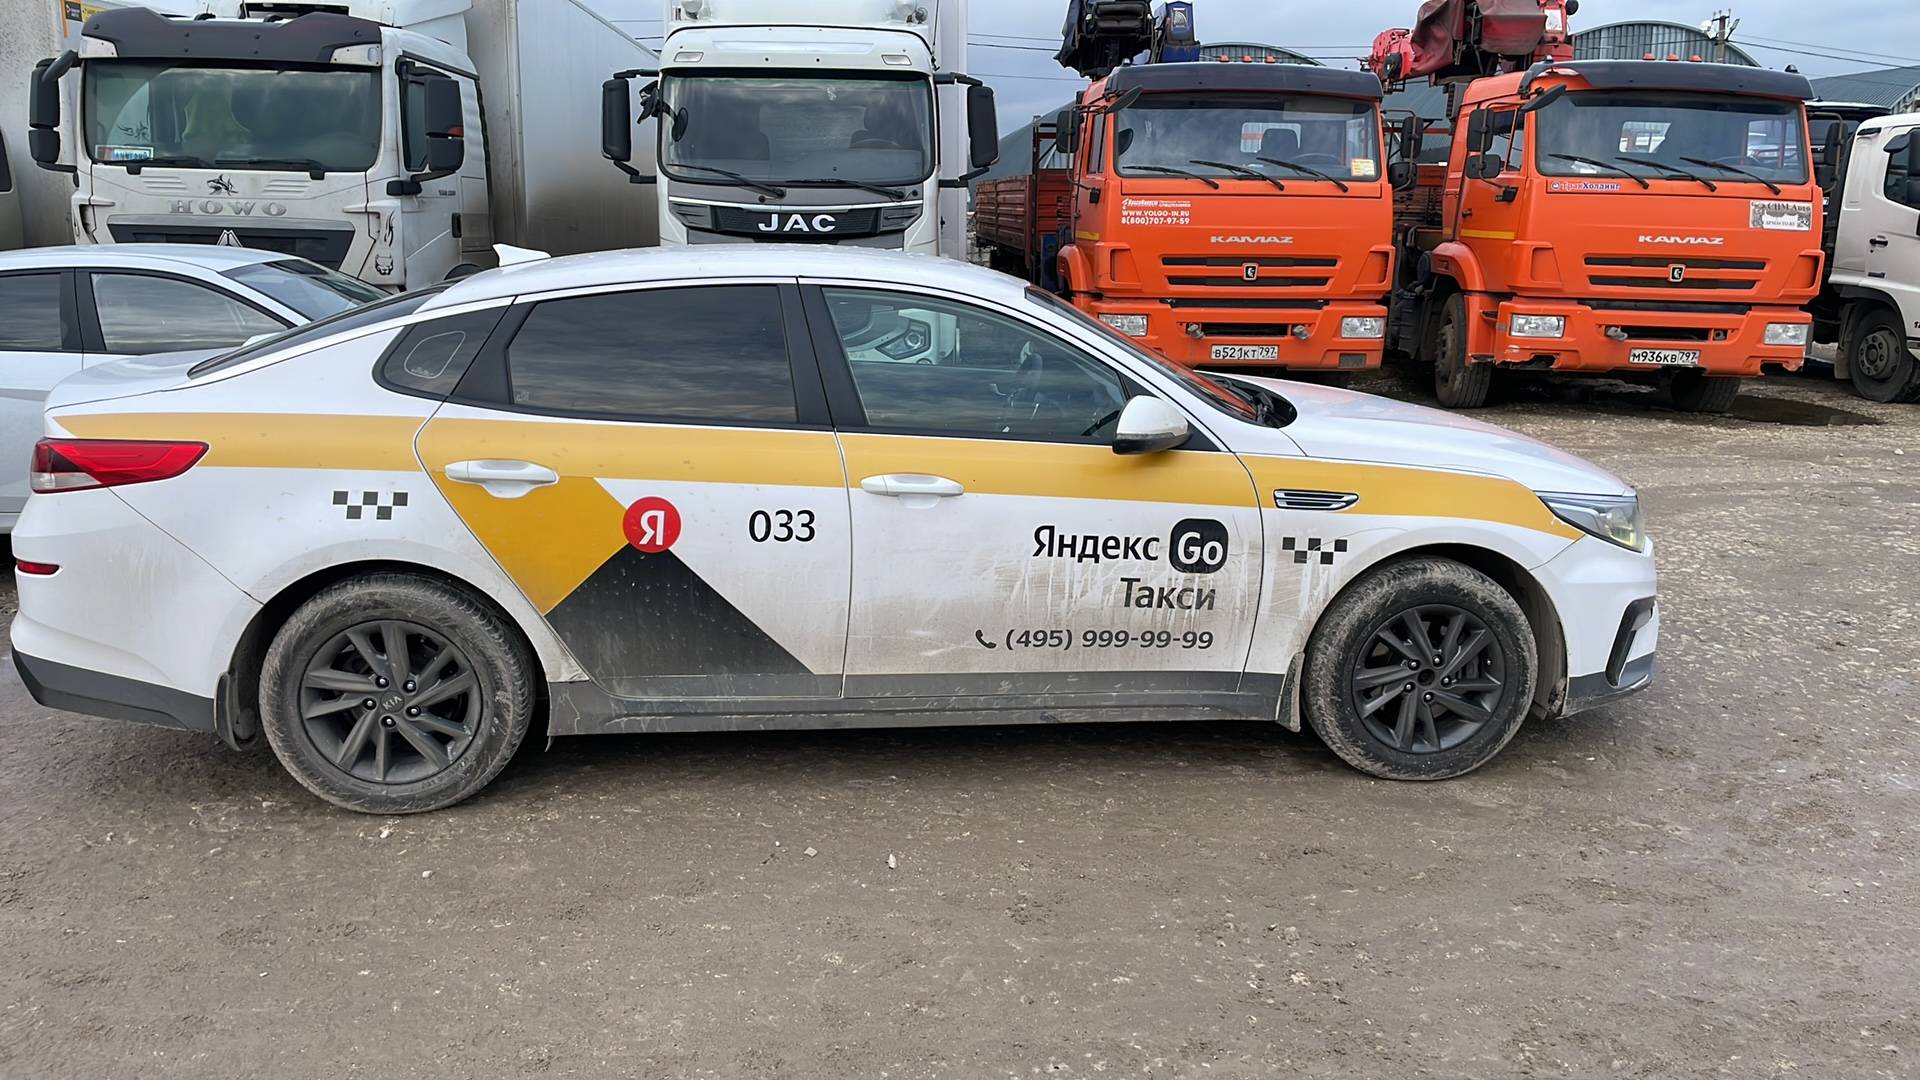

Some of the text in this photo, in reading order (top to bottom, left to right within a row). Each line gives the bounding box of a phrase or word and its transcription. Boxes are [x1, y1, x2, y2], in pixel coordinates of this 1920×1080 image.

[168, 200, 287, 216] HOWO
[758, 213, 836, 232] JAC
[1638, 235, 1724, 245] KAMAZ
[638, 510, 665, 546] Я
[748, 509, 816, 543] 033
[1032, 525, 1226, 566] Яндекс Go
[1120, 577, 1217, 611] Такси
[1005, 628, 1215, 651] (495) 999-99-99
[383, 696, 402, 710] KIA
